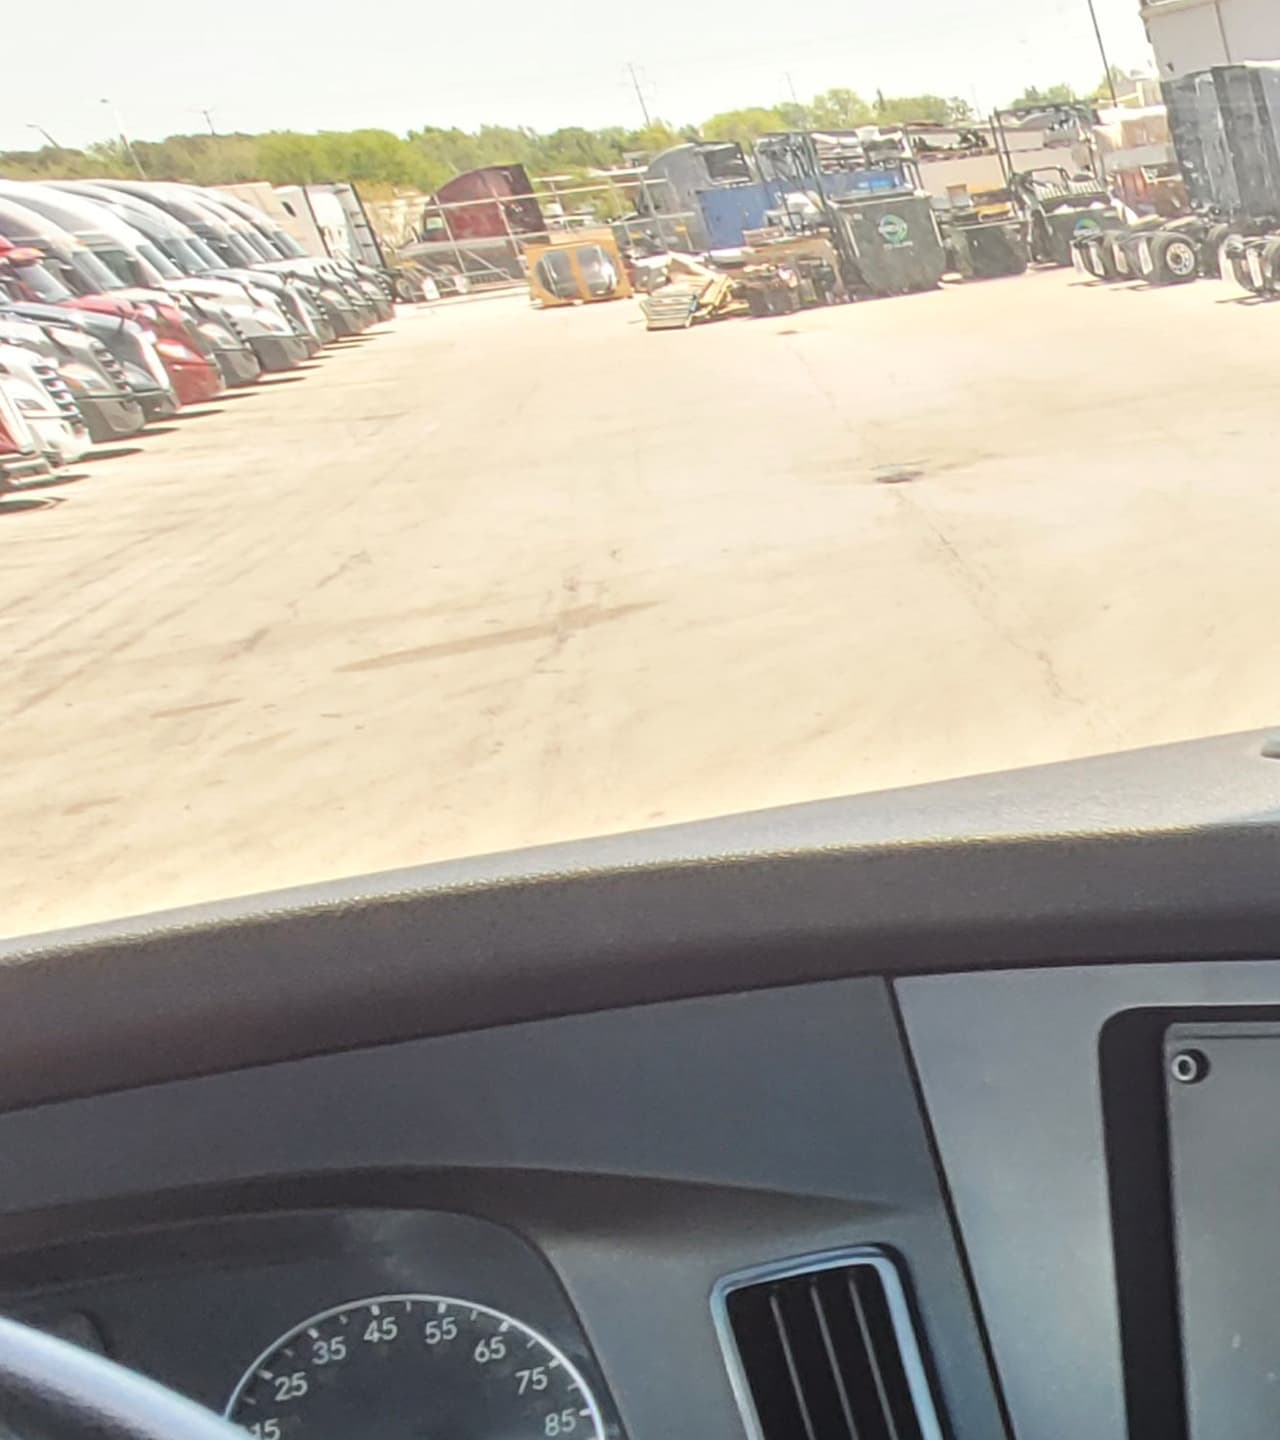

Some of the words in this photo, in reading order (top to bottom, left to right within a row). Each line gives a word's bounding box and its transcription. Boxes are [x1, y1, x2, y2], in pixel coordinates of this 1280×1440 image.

[363, 1317, 398, 1343] 45
[424, 1317, 458, 1345] 55
[312, 1336, 347, 1365] 35
[474, 1336, 507, 1363] 65
[274, 1372, 309, 1401] 25
[515, 1367, 549, 1395] 75
[544, 1408, 577, 1437] 85
